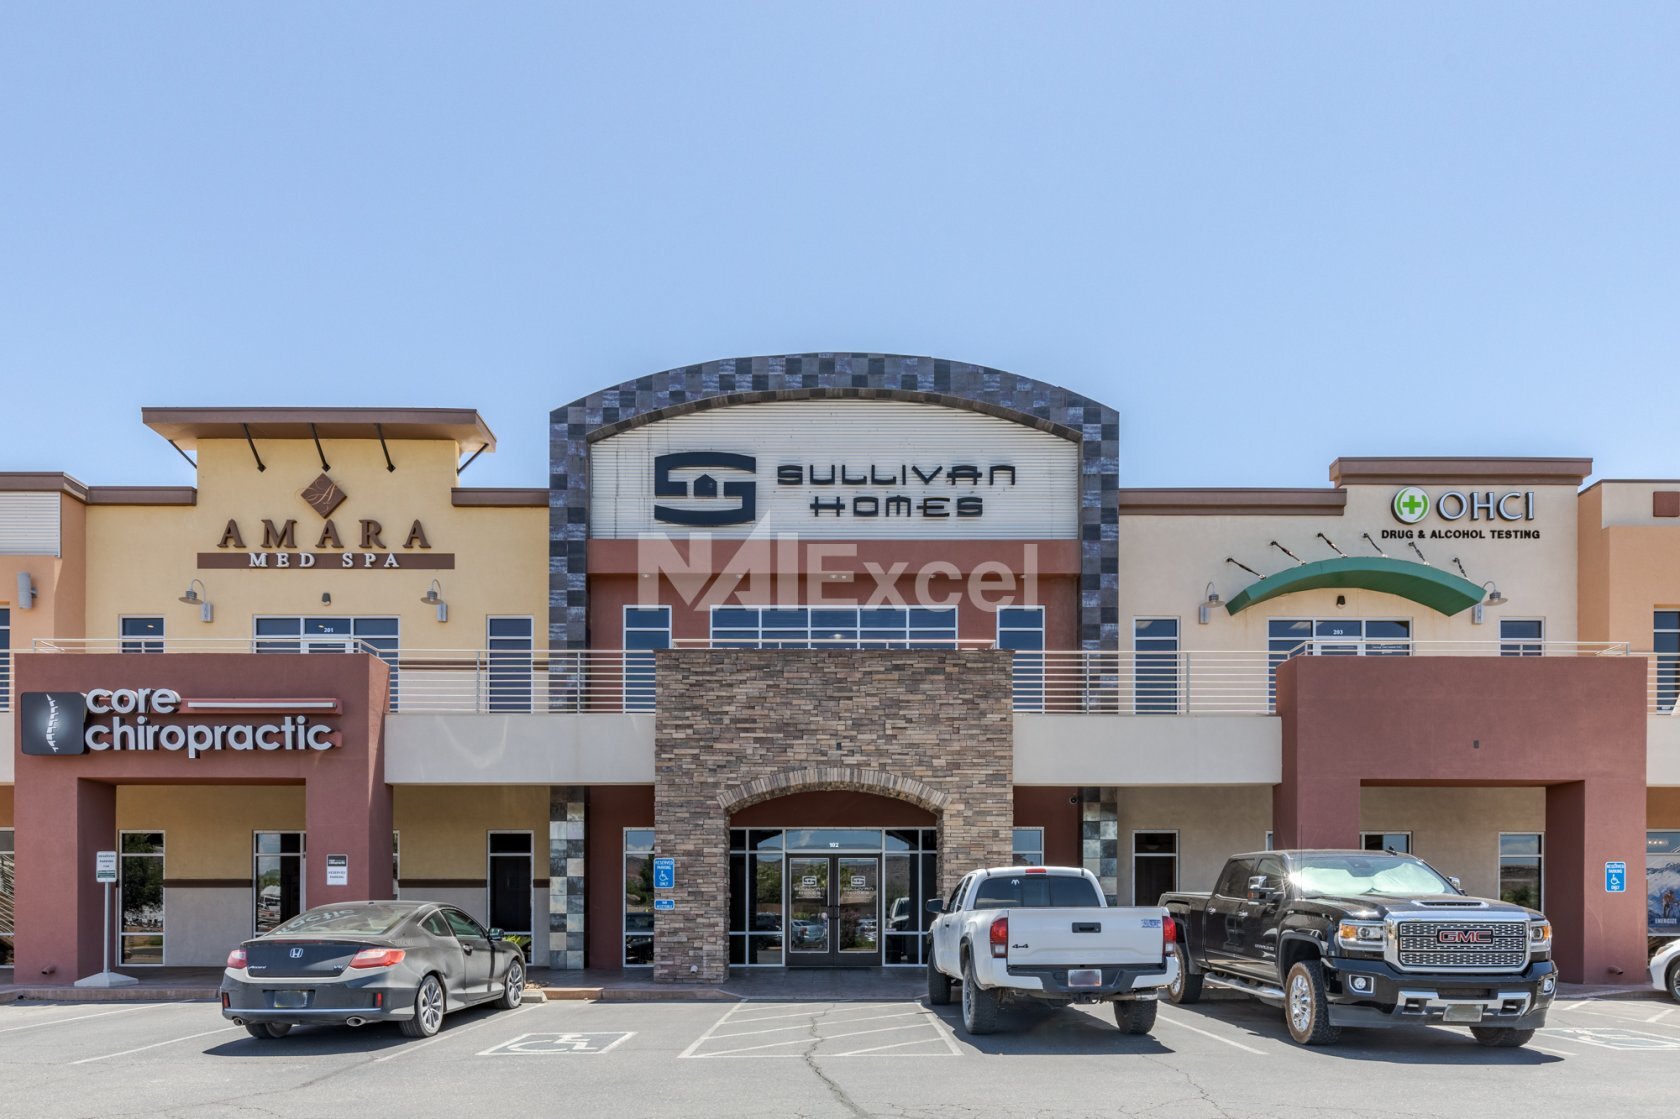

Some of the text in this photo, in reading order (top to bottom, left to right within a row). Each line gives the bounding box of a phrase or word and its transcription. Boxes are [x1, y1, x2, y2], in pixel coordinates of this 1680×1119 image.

[777, 465, 1016, 486] SULLIVAN
[809, 495, 983, 517] HOMES
[1436, 491, 1535, 522] OHCI
[216, 518, 432, 549] AMARA
[1381, 529, 1540, 539] DRUG & ALCOHOL TESTING
[249, 552, 400, 568] MED SPA
[86, 688, 178, 714] core
[84, 715, 333, 759] chiropractic
[1439, 930, 1492, 943] GMC
